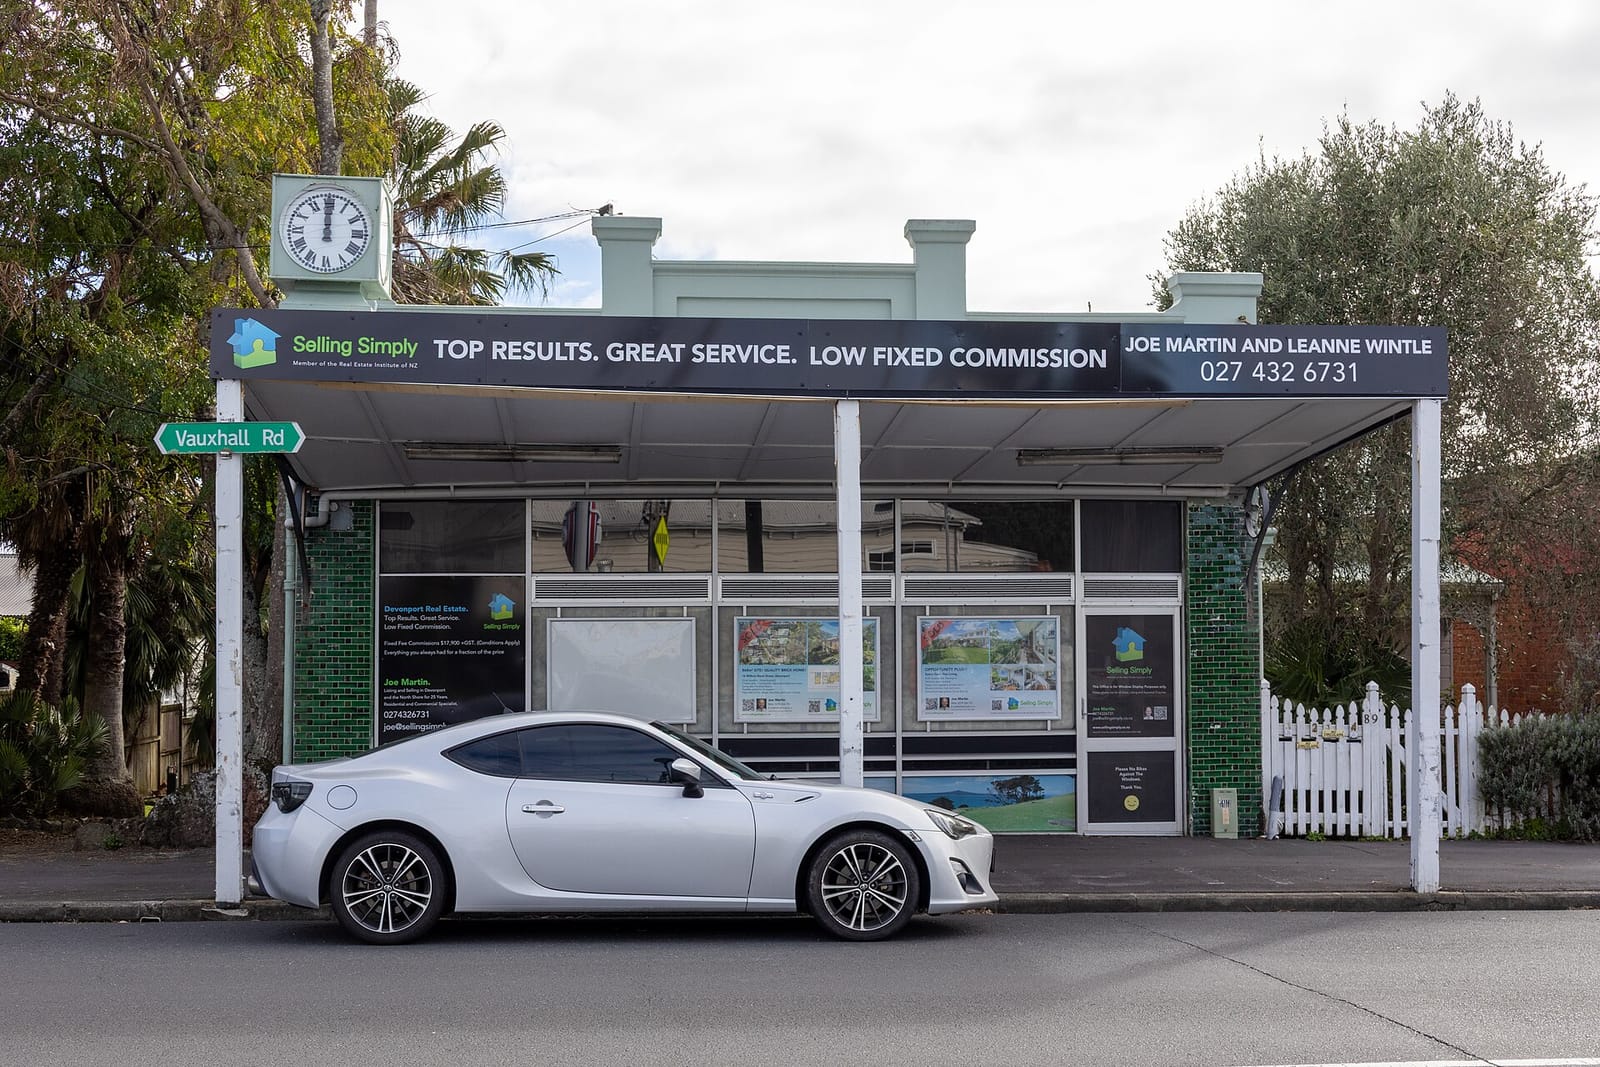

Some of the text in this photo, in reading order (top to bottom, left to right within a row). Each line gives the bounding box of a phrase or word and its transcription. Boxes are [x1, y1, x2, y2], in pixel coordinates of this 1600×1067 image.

[292, 335, 418, 358] Selling Simply
[433, 340, 1107, 368] TOP RESULTS. GREAT SERVICE. LOW FIXED COMMISSION
[1125, 336, 1432, 354] JOE MARTIN AND LEANNE WINTLE
[1200, 361, 1358, 382] 027 432 6731
[175, 428, 284, 446] Vauxhall Rd
[1106, 666, 1152, 675] Selling Simply
[1312, 723, 1318, 732] 2
[1351, 722, 1356, 731] 4
[1364, 714, 1378, 724] 89
